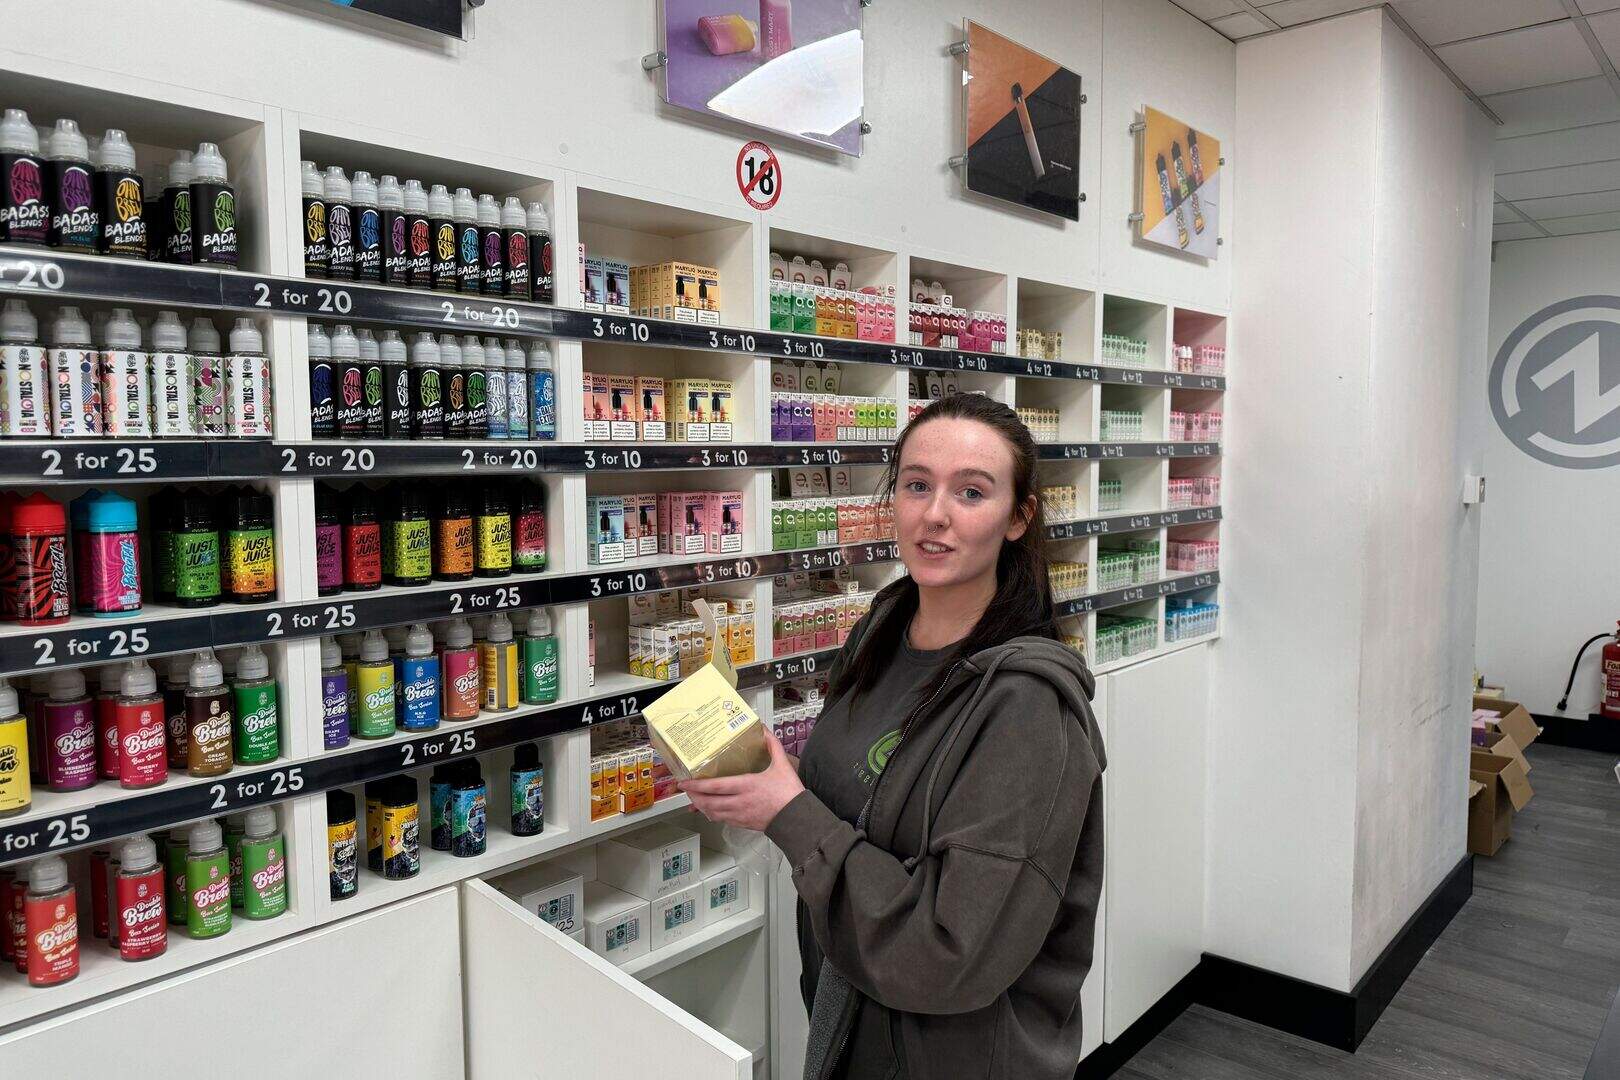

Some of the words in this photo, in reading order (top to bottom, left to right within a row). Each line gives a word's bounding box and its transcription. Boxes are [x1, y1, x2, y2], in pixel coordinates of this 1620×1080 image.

[744, 156, 774, 195] 18
[0, 205, 49, 221] BADASS
[53, 212, 99, 229] BADASS
[9, 219, 43, 229] BLENDS
[62, 226, 93, 235] BLENDS
[114, 235, 143, 244] BLENDS
[15, 260, 64, 291] 20
[605, 262, 628, 271] MARYLIQ
[674, 265, 696, 274] MARYLIQ
[697, 269, 718, 277] MARYLIQ
[254, 283, 271, 306] 2
[282, 289, 308, 305] for
[318, 289, 352, 313] 20
[440, 301, 457, 322] 2
[462, 307, 486, 321] for
[490, 307, 522, 328] 20
[593, 318, 603, 337] 3
[609, 323, 626, 335] for
[630, 323, 649, 341] 10
[710, 331, 718, 348] 3
[723, 335, 737, 346] for
[740, 335, 755, 351] 10
[783, 339, 791, 355] 3
[795, 342, 807, 353] for
[810, 342, 823, 357] 10
[891, 349, 897, 363] 3
[900, 352, 910, 361] for
[912, 352, 923, 366] 10
[958, 356, 964, 368] 3
[966, 358, 975, 367] for
[977, 357, 987, 370] 10
[1027, 362, 1033, 374] 4
[1034, 364, 1042, 373] for
[1043, 364, 1052, 376] 12
[1076, 367, 1082, 379] 4
[1091, 369, 1099, 380] 12
[19, 364, 34, 418] NOSTALGIA
[58, 367, 72, 419] NOSTALGIA
[126, 368, 141, 419] NOSTALGIA
[165, 370, 179, 419] NOSTALGIA
[242, 372, 255, 420] NOSTALGIA
[42, 450, 63, 475] 2
[75, 453, 108, 469] for
[117, 448, 157, 473] 25
[282, 449, 297, 471] 2
[308, 452, 333, 466] for
[342, 449, 374, 470] 20
[462, 449, 476, 469] 2
[483, 452, 504, 467] for
[510, 449, 537, 469] 20
[585, 451, 595, 468] 3
[601, 453, 618, 464] for
[622, 451, 641, 468] 10
[702, 450, 710, 466] 3
[715, 452, 729, 462] for
[732, 450, 747, 465] 10
[802, 449, 809, 464] 3
[813, 452, 824, 461] for
[827, 449, 840, 463] 10
[882, 448, 888, 462] 3
[407, 526, 428, 539] JUST
[1100, 521, 1108, 532] 12
[186, 540, 214, 554] JUST
[243, 537, 269, 551] JUST
[866, 547, 873, 561] 3
[876, 548, 886, 557] for
[889, 543, 901, 558] 10
[243, 547, 271, 562] JUICE
[803, 554, 810, 569] 3
[814, 555, 825, 564] for
[828, 550, 842, 566] 10
[705, 565, 714, 581] 3
[719, 566, 732, 576] for
[736, 561, 751, 577] 10
[591, 578, 601, 596] 3
[607, 579, 623, 590] for
[628, 573, 646, 591] 10
[450, 594, 463, 613] 2
[470, 594, 491, 607] for
[496, 587, 520, 608] 25
[267, 613, 283, 636] 2
[292, 614, 318, 628] for
[324, 605, 356, 628] 25
[34, 639, 55, 665] 2
[67, 639, 101, 655] for
[109, 628, 149, 656] 25
[775, 664, 783, 679] 3
[787, 664, 799, 674] for
[802, 657, 815, 673] 10
[405, 684, 435, 701] Brew
[582, 707, 593, 724] 4
[599, 706, 615, 717] for
[621, 697, 638, 716] 12
[248, 713, 277, 733] Brew
[124, 733, 165, 754] Brew
[193, 725, 232, 745] Brew
[401, 744, 415, 765] 2
[422, 743, 444, 756] for
[450, 730, 476, 754] 25
[137, 763, 159, 771] CHERRY
[210, 784, 227, 809] 2
[237, 782, 264, 797] for
[271, 768, 303, 795] 25
[3, 832, 39, 851] for
[48, 815, 90, 847] 25
[136, 896, 160, 911] Double
[123, 907, 162, 926] Brew
